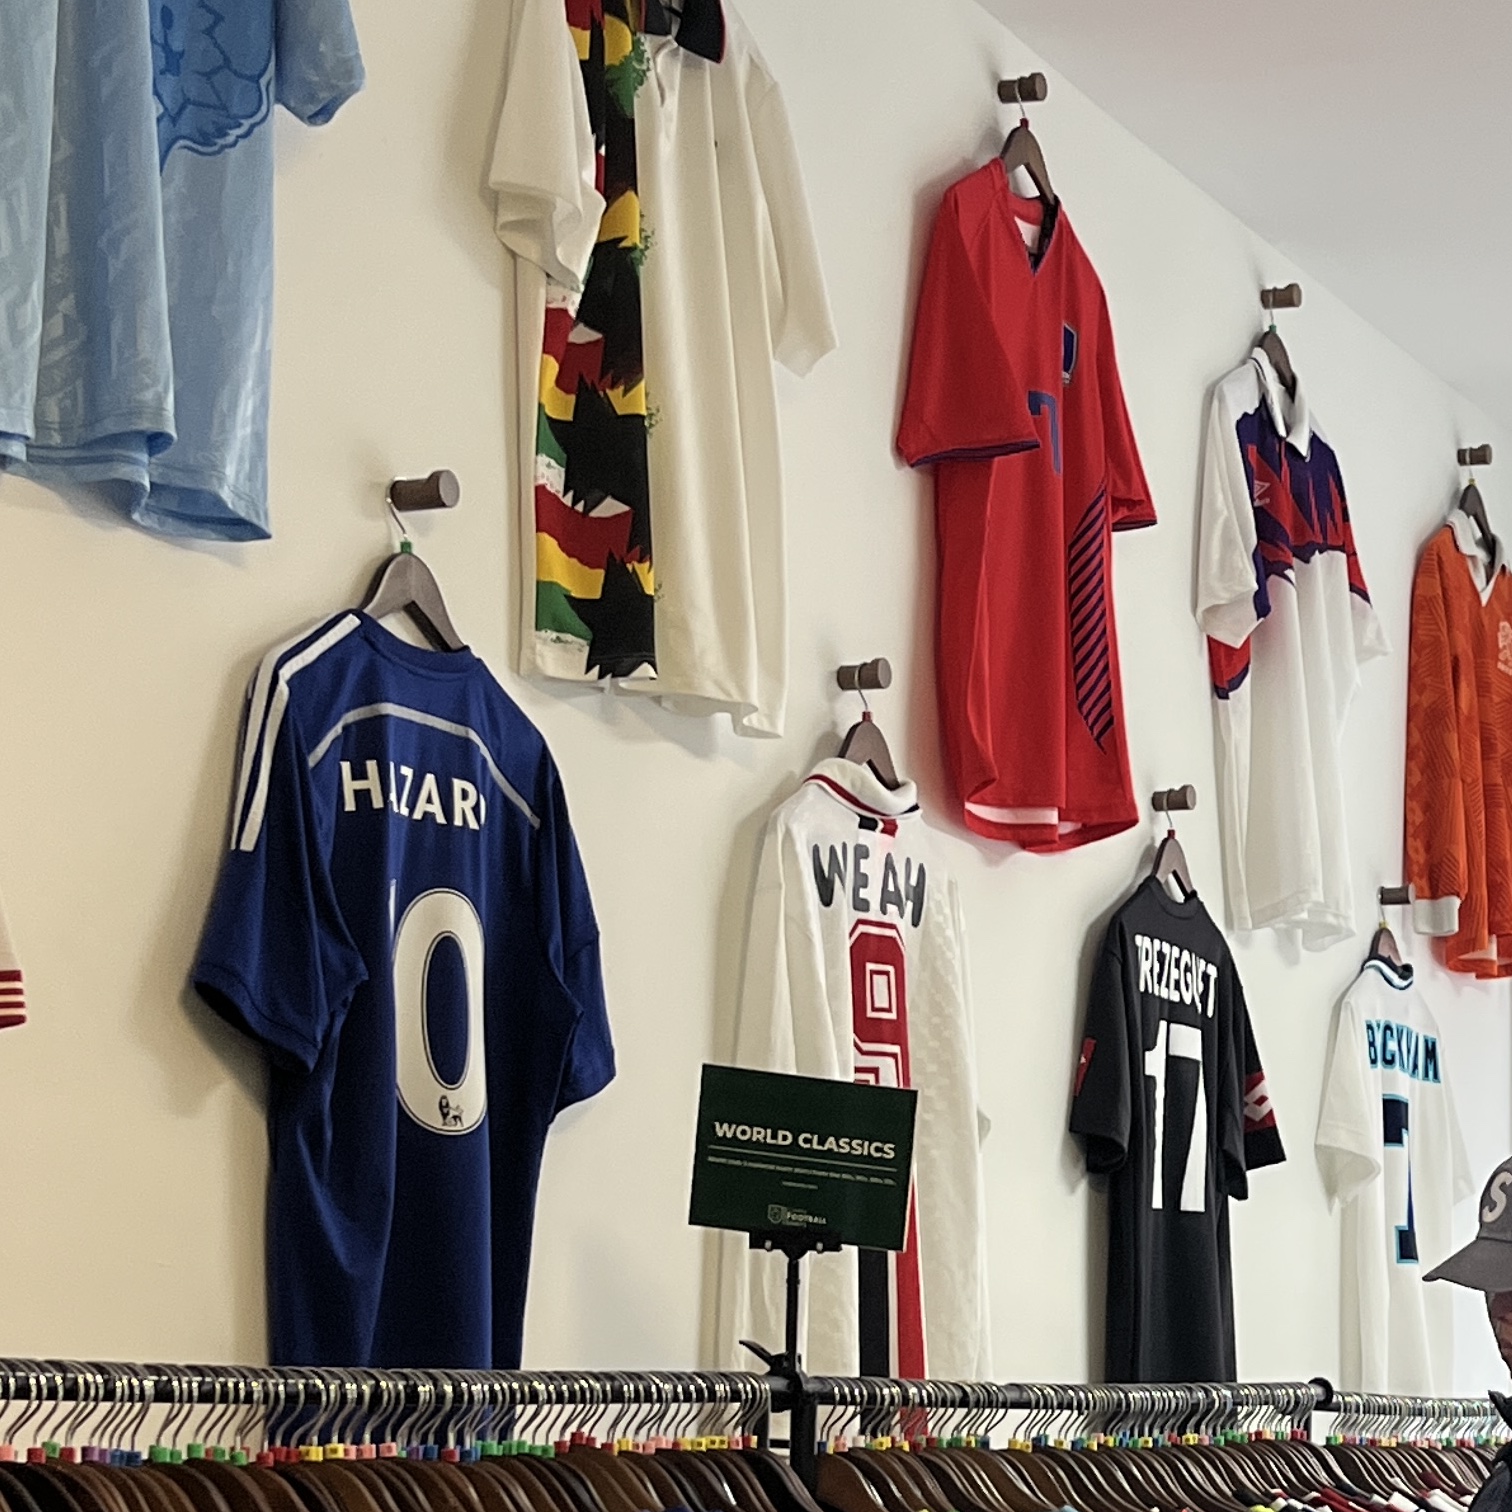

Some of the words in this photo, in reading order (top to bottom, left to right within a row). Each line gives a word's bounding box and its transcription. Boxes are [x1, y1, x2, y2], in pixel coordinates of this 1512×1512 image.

[812, 841, 927, 929] WEAH
[389, 877, 489, 1136] 0
[1364, 1019, 1441, 1084] BCKAM
[714, 1121, 794, 1147] WORLD
[798, 1131, 897, 1160] CLASSICS
[1144, 1019, 1208, 1213] 17
